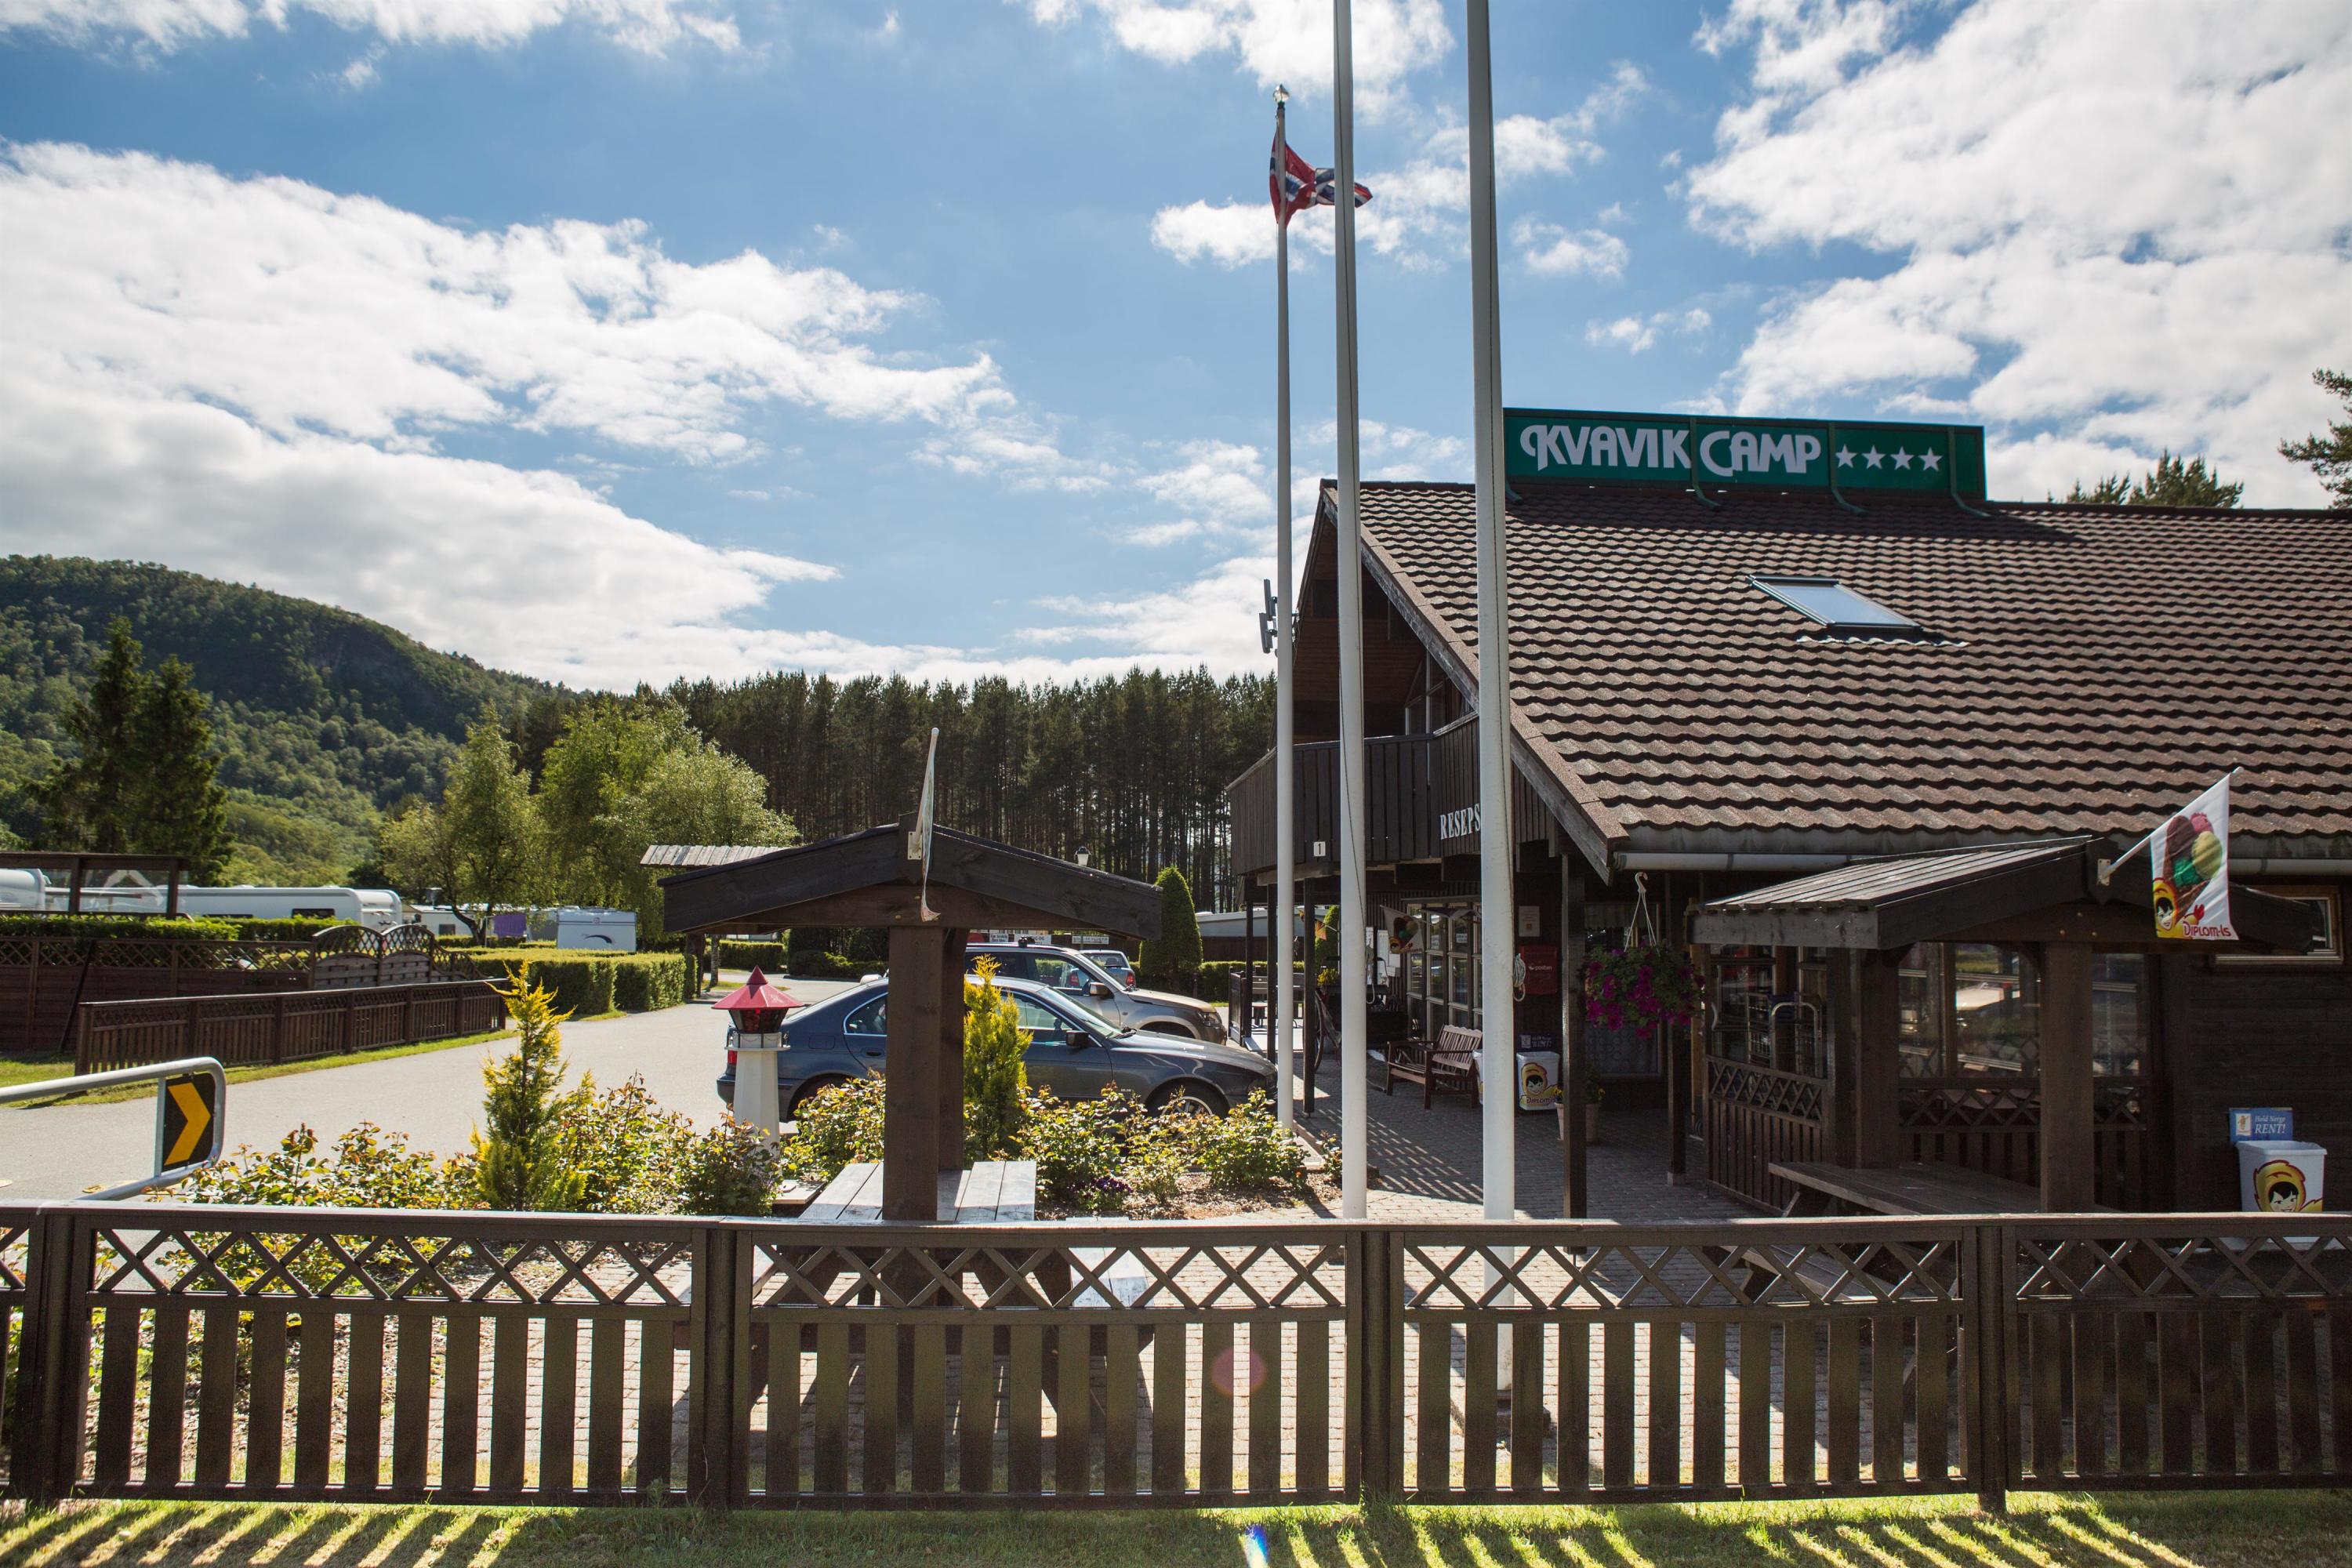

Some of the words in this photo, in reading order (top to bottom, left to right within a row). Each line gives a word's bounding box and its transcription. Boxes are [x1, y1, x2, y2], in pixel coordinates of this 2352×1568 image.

[1519, 424, 1692, 471] KVAVIK
[1700, 430, 1821, 477] CAMP
[2255, 1123, 2286, 1134] RENT!
